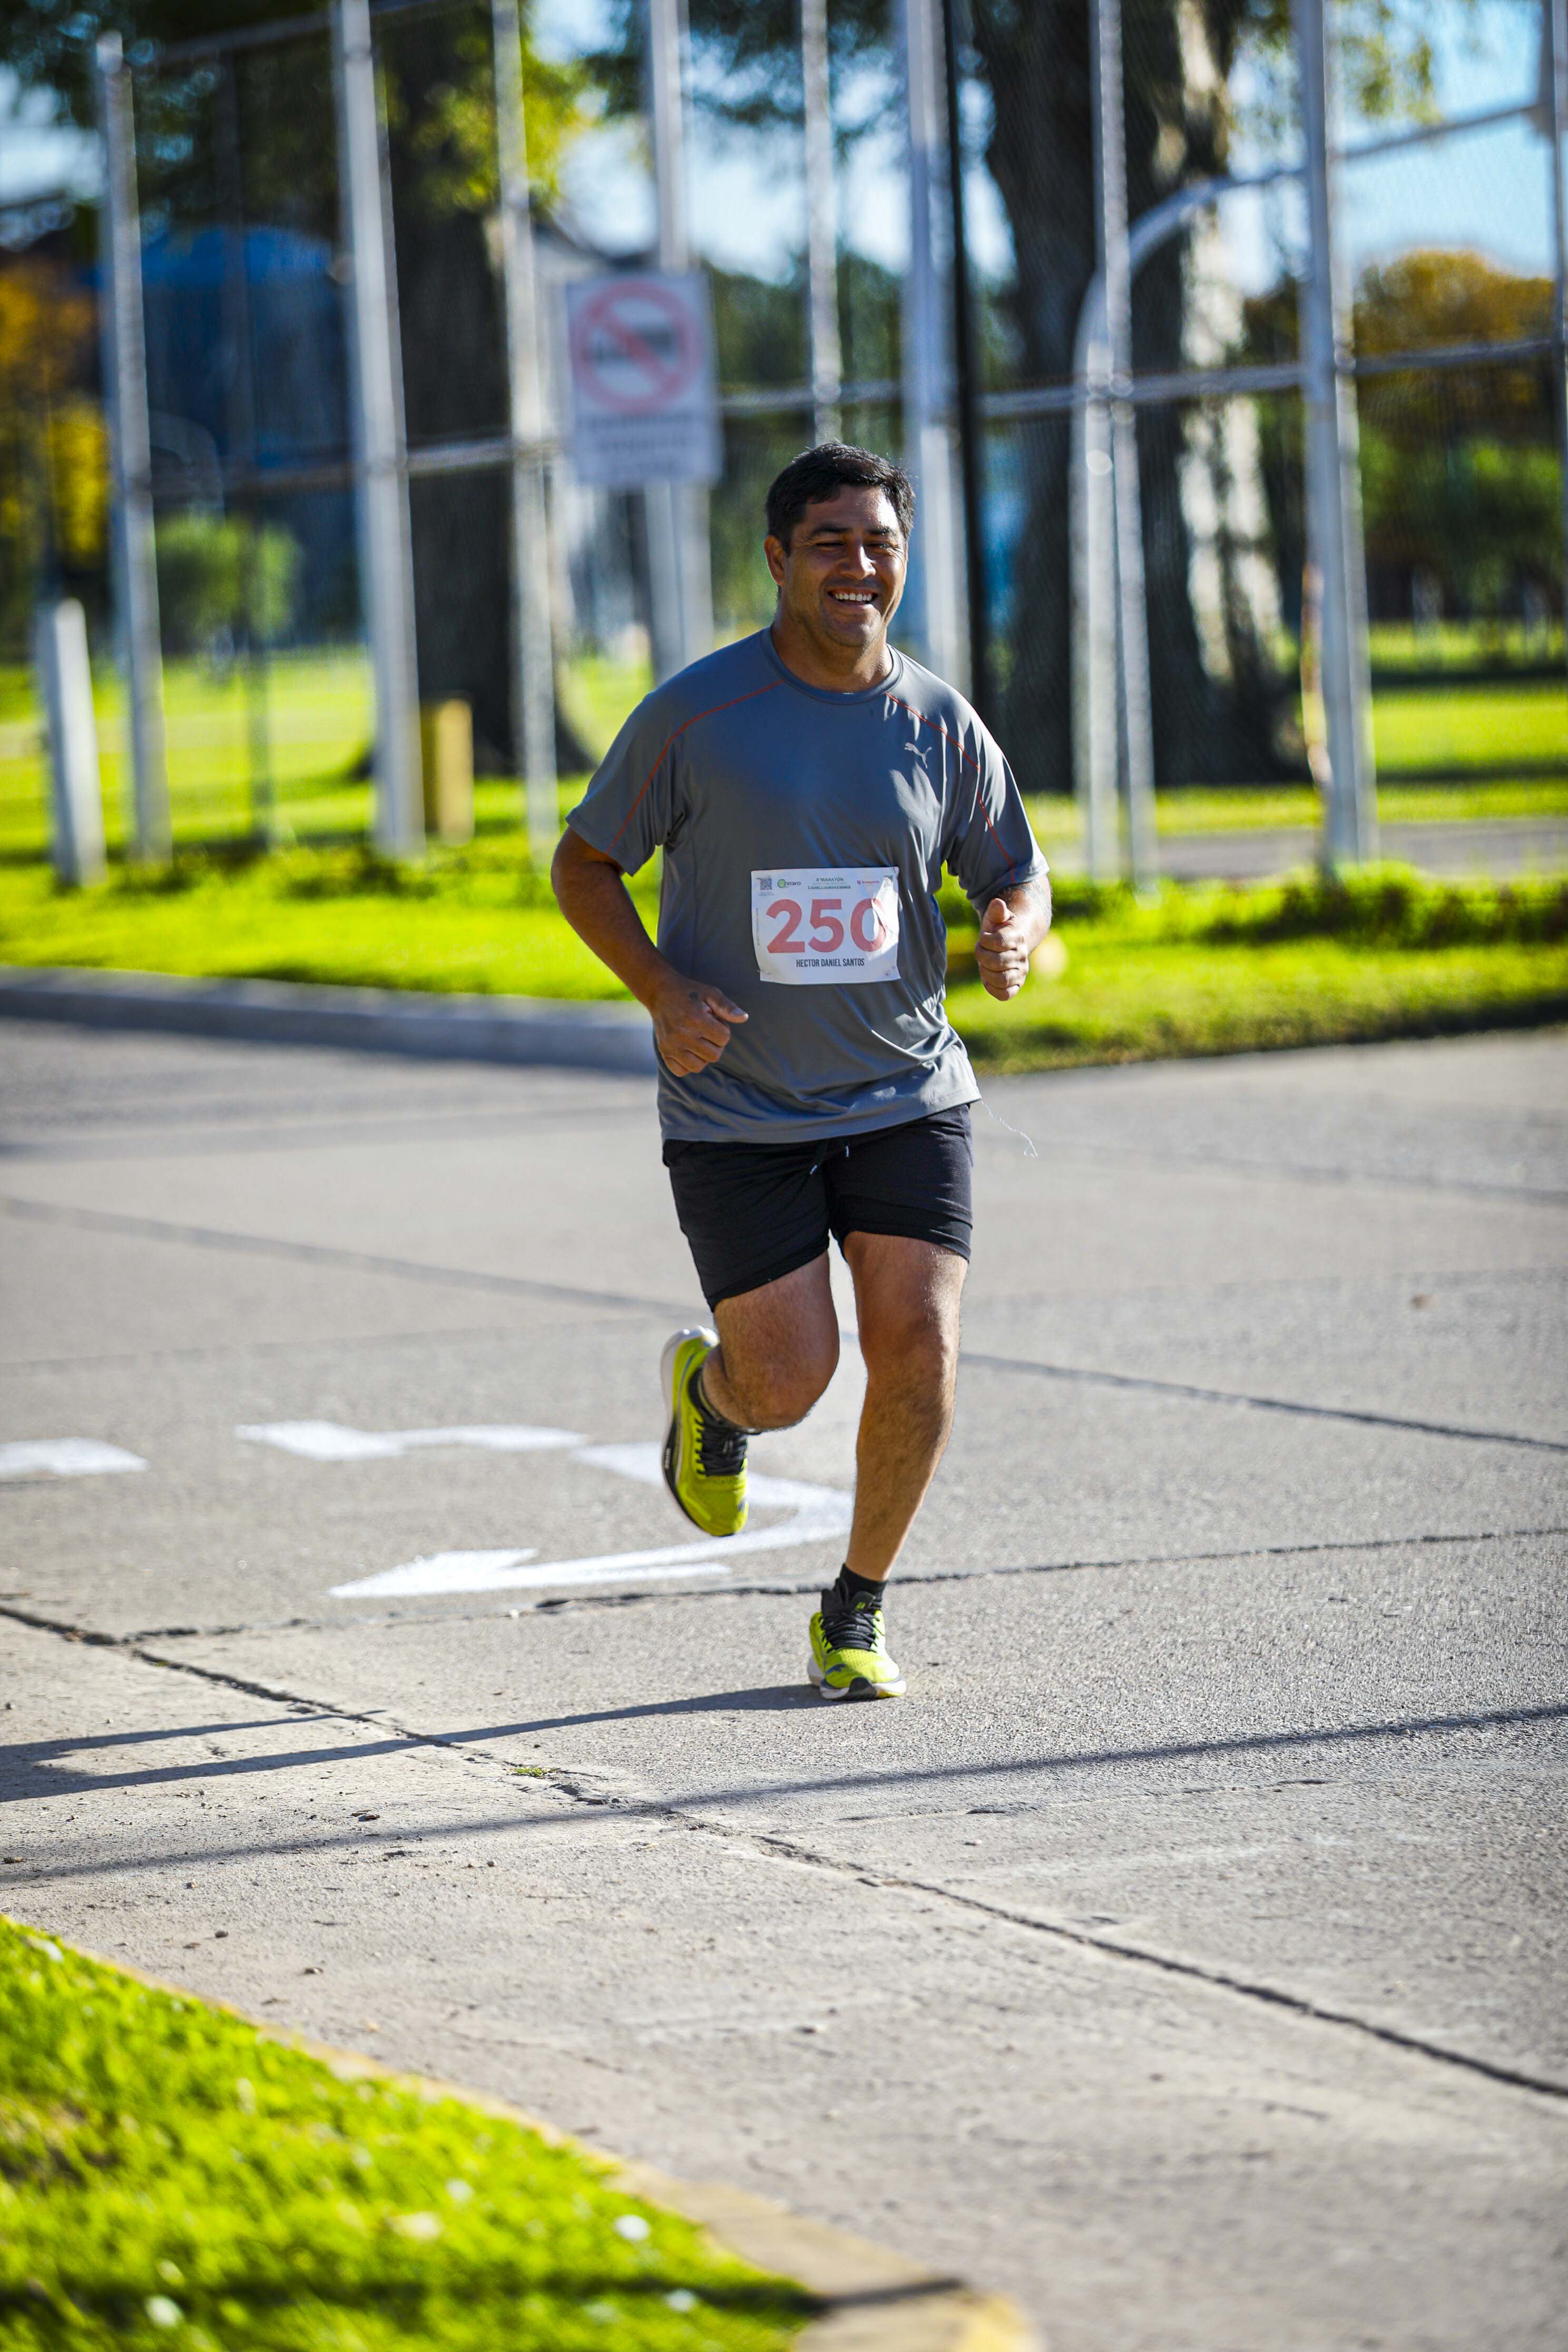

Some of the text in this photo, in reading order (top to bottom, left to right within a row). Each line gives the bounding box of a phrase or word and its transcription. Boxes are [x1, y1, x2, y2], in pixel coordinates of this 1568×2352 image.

[766, 897, 886, 953] 250
[796, 958, 819, 967] HECTOR
[842, 958, 865, 966] SANTOS
